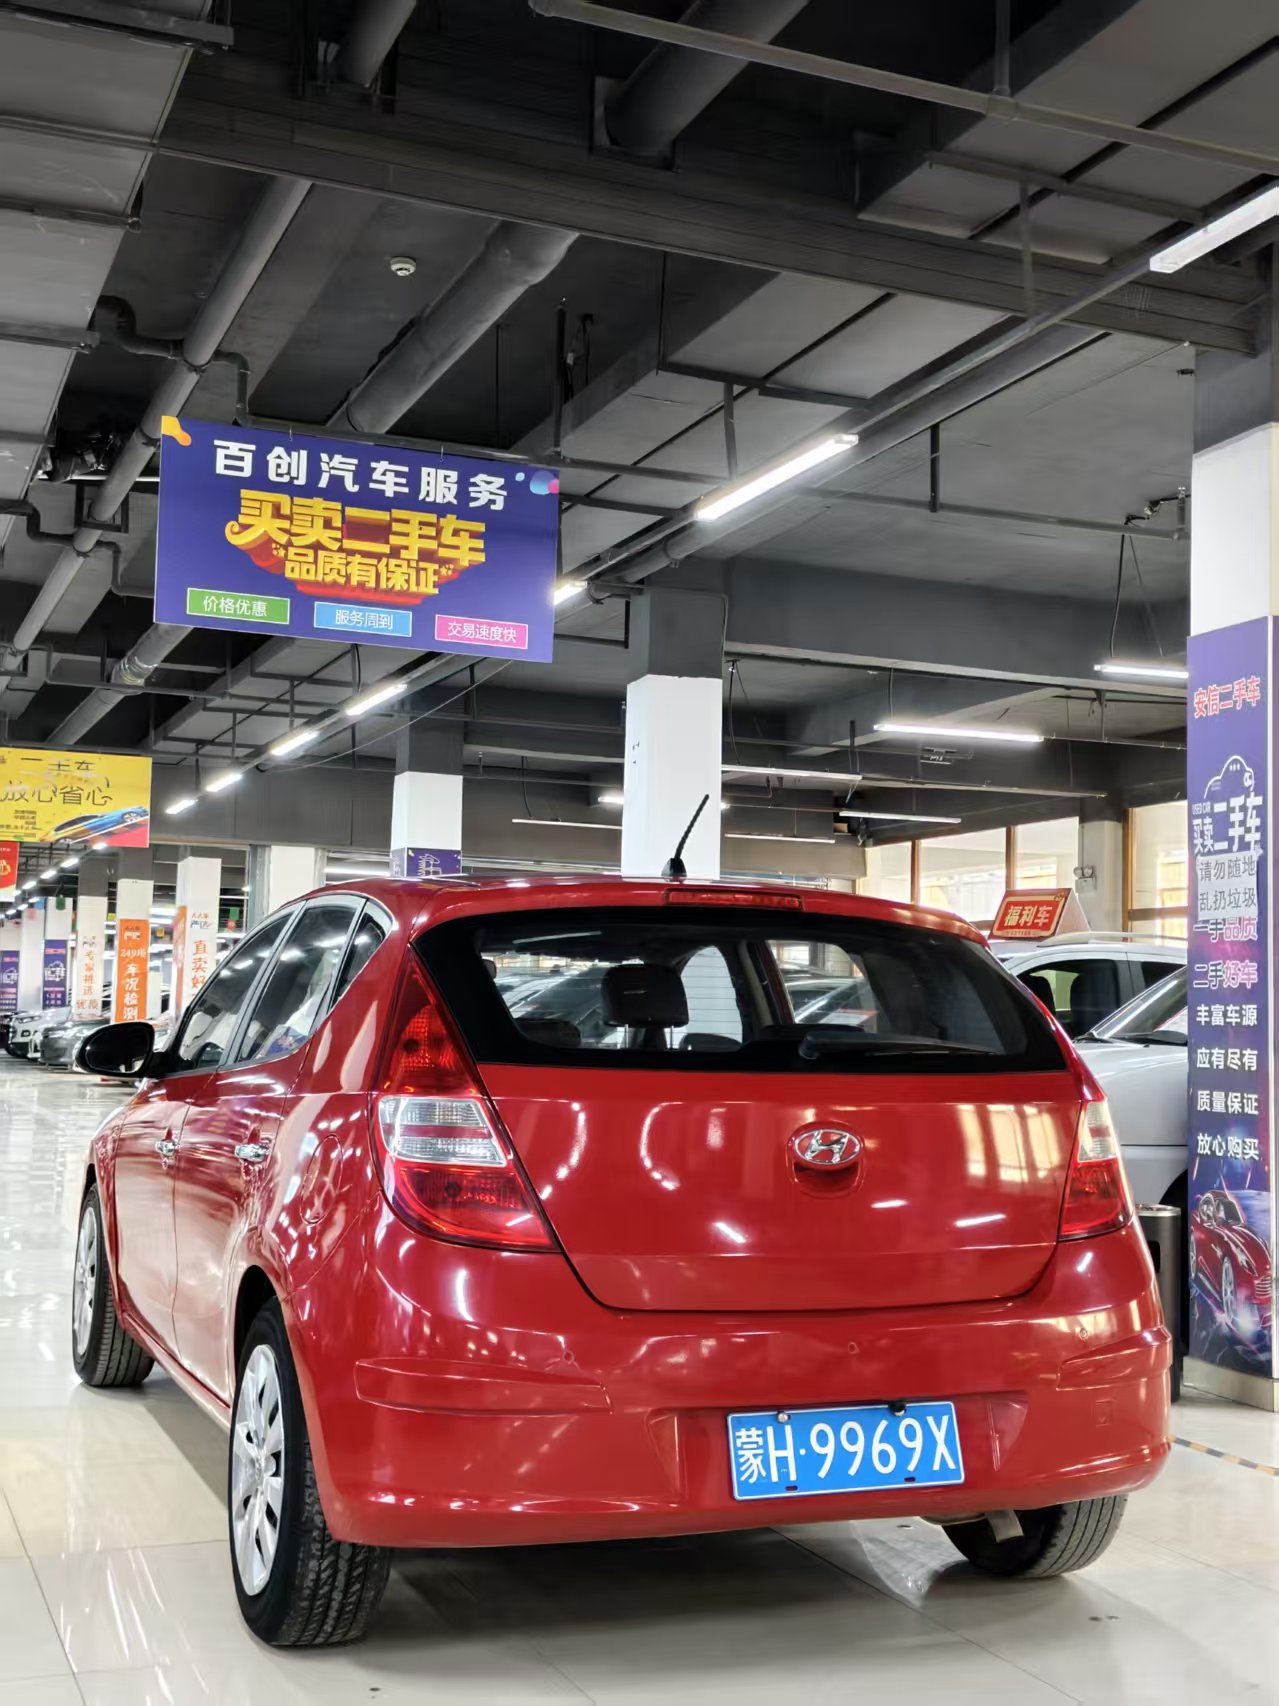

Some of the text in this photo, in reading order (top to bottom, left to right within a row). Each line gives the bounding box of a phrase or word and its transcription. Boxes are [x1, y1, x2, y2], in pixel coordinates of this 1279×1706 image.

[213, 439, 508, 510] 百创汽车服务
[225, 489, 486, 566] 买卖二手车
[203, 595, 268, 617] 价格优惠
[334, 608, 394, 630] 服务周到
[447, 621, 518, 644] 交易速度快
[1193, 675, 1261, 718] 安信二手车
[1199, 855, 1256, 882] 请勿随地
[1199, 887, 1256, 912] 乱扔垃圾
[1004, 905, 1053, 927] 福利车
[1193, 960, 1258, 989] 二手好车
[1196, 1004, 1258, 1027] 丰富车源
[1196, 1047, 1258, 1071] 应有尽有
[1197, 1090, 1259, 1115] 质量保证
[1197, 1133, 1260, 1160] 放心购买
